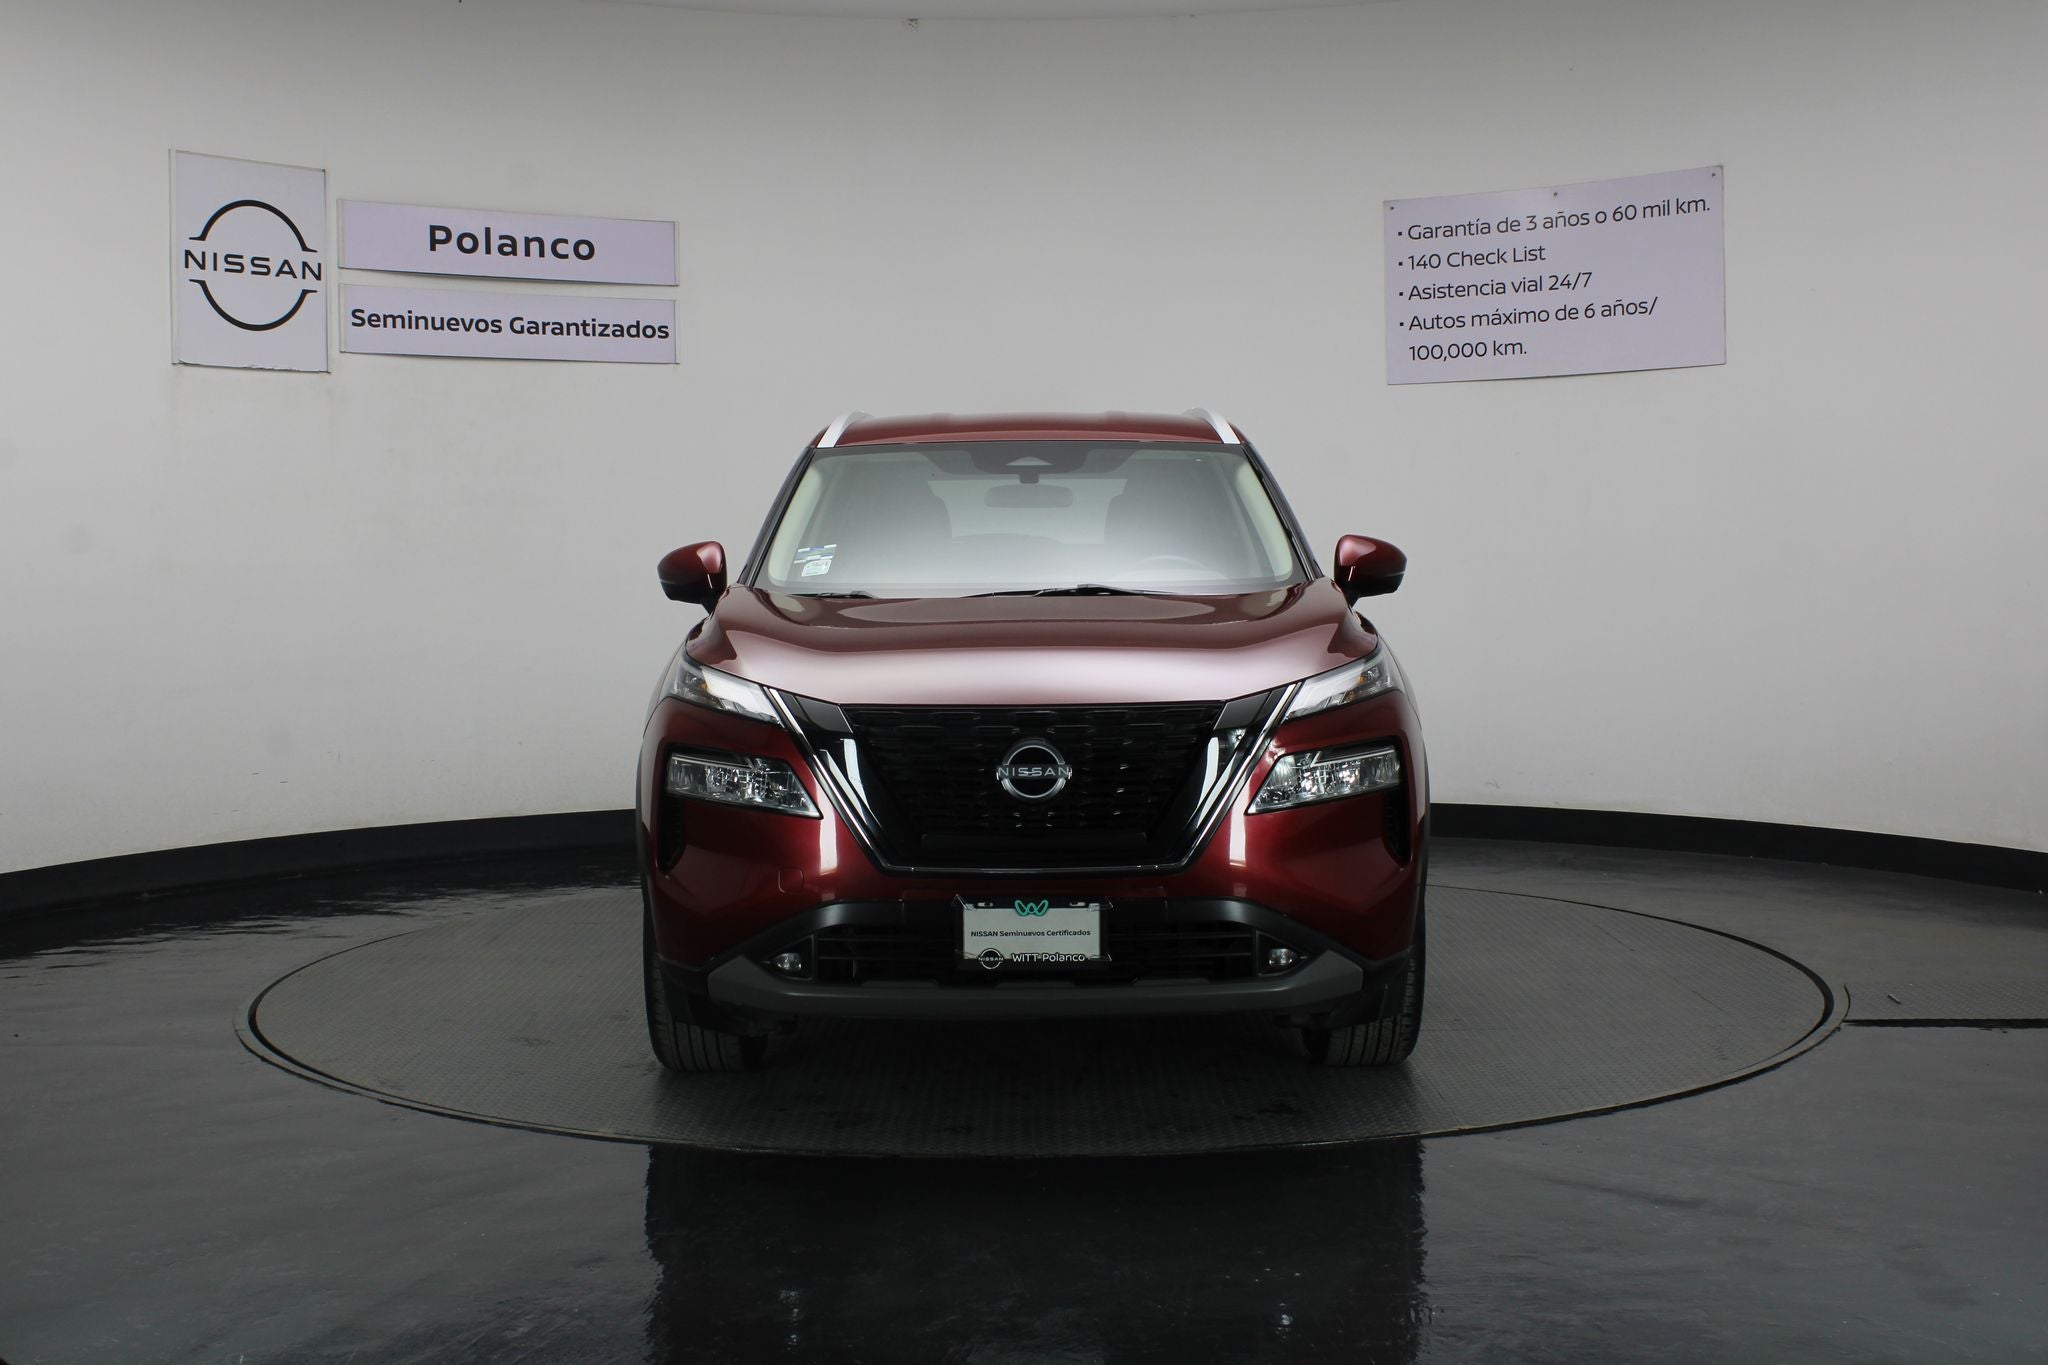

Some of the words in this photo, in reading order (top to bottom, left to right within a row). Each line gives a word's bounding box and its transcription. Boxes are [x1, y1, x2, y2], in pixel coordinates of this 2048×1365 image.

[1407, 219, 1491, 241] Garantía
[1496, 217, 1522, 234] de
[1526, 216, 1538, 231] 3
[1542, 211, 1591, 229] años
[1594, 210, 1608, 224] o
[1612, 204, 1638, 222] 60
[1642, 199, 1671, 219] mil
[1675, 198, 1711, 215] km.
[428, 224, 596, 261] Polanco
[1408, 254, 1442, 270] 140
[1446, 249, 1508, 268] Check
[1512, 245, 1546, 263] List
[184, 248, 323, 282] NISSAN
[1408, 279, 1507, 301] Asistencia
[1511, 276, 1543, 293] vial
[1548, 271, 1593, 291] 24/7
[351, 308, 503, 335] Seminuevos
[508, 315, 670, 340] Garantizados
[1409, 312, 1466, 331] Autos
[1471, 306, 1550, 327] máximo
[1554, 305, 1579, 321] de
[1584, 303, 1596, 319] 6
[1600, 296, 1658, 317] años/
[1409, 341, 1488, 362] 100,000
[1492, 340, 1528, 356] km.
[998, 767, 1070, 777] NISSAN
[1012, 953, 1038, 962] WITT
[1042, 953, 1085, 962] Polanco
